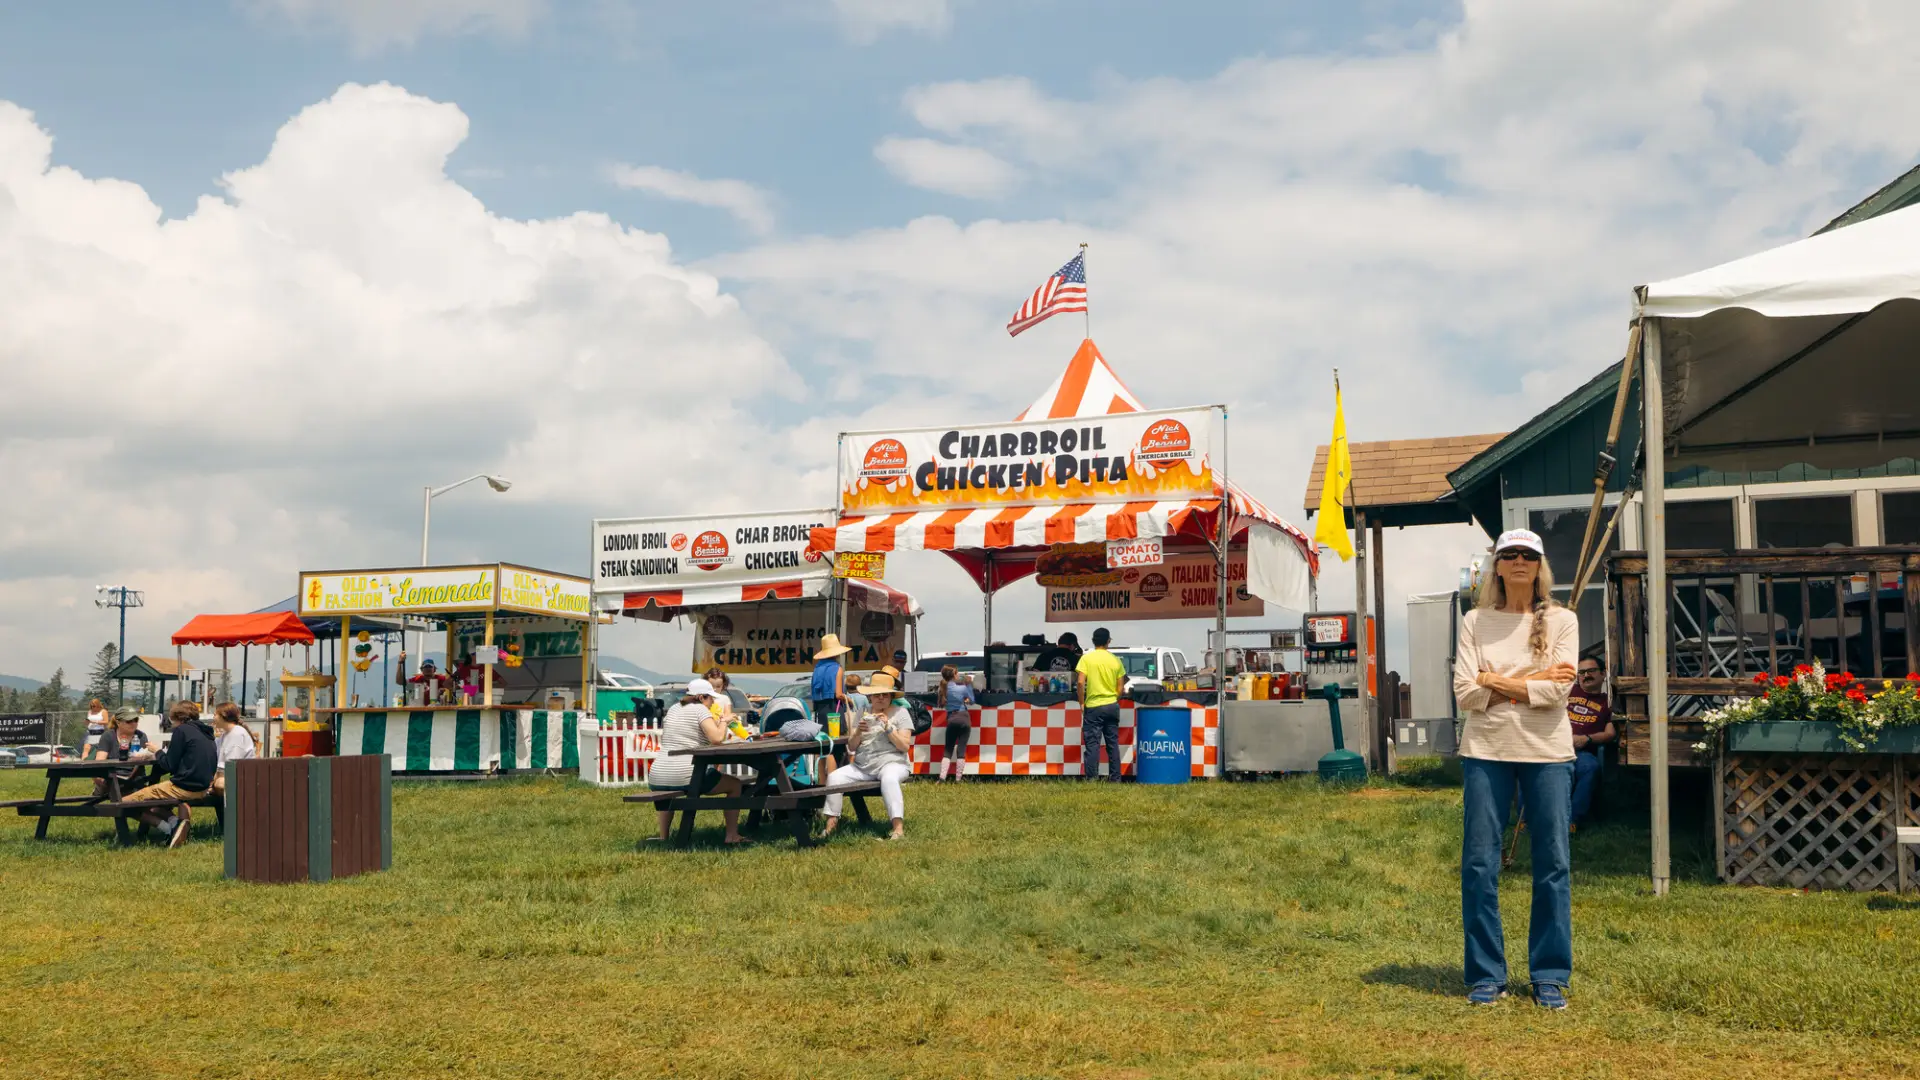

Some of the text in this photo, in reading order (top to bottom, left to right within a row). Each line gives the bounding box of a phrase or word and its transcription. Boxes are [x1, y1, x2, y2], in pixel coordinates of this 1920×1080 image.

[1151, 423, 1180, 434] Nick
[873, 443, 899, 453] Nick
[939, 426, 1106, 459] CHARBROIL
[1137, 450, 1192, 461] AMERICAN GRILLE
[915, 454, 1129, 491] CHICKEN PITA
[603, 533, 639, 552] LONDON
[641, 532, 668, 550] BROIL
[735, 526, 770, 545] CHAR
[841, 552, 881, 563] BUCKET
[1109, 543, 1161, 556] TOMATO
[1121, 553, 1161, 565] SALAD
[601, 557, 679, 578] STEAK SANDWICH
[745, 550, 800, 571] CHICKEN
[513, 573, 531, 590] OLD
[844, 569, 873, 578] FRIES
[1171, 564, 1210, 584] ITALIAN
[342, 571, 492, 607] OLD Lemonade
[501, 587, 543, 608] FASHION
[1181, 587, 1233, 607] SANDWH
[325, 592, 383, 610] FASHION
[1051, 590, 1130, 612] STEAK SANDWICH
[747, 627, 826, 641] CHARBRO
[714, 646, 815, 666] CHICKEN
[1139, 740, 1186, 756] AQUAFINA
